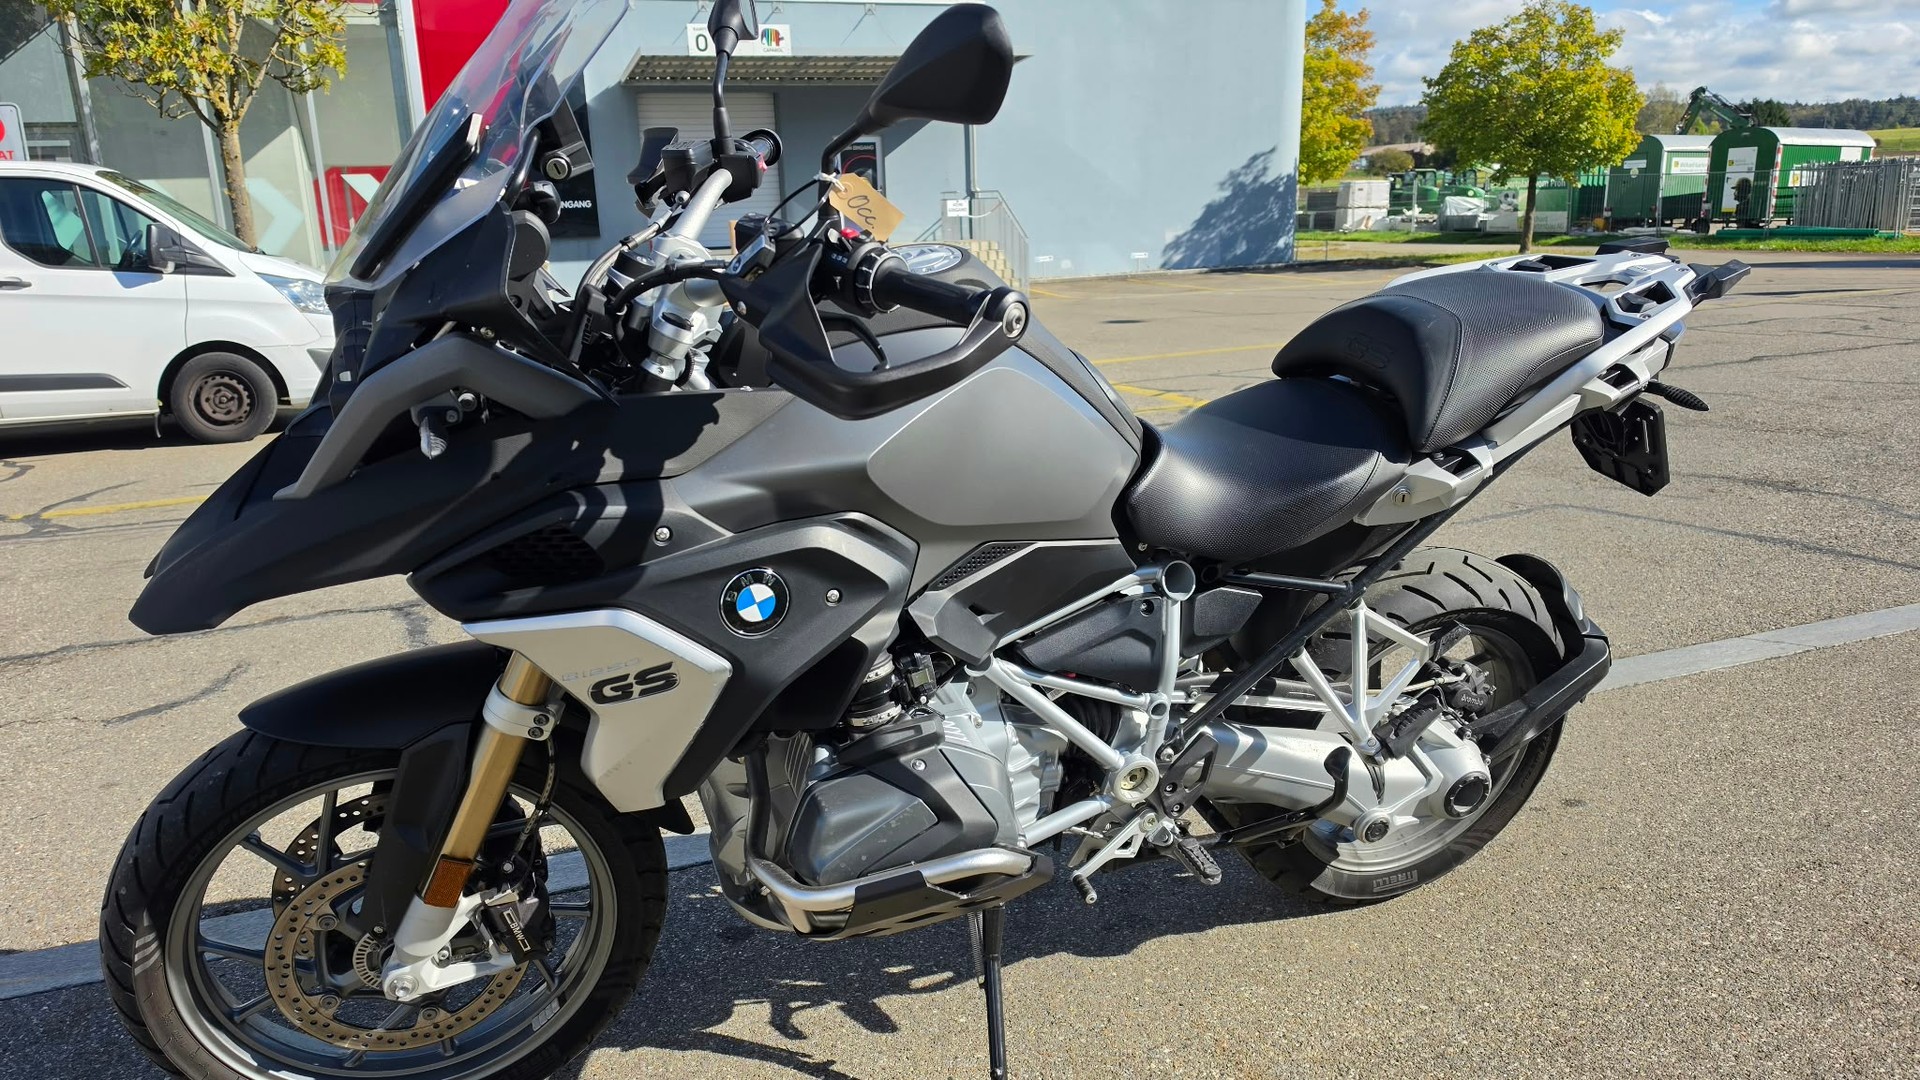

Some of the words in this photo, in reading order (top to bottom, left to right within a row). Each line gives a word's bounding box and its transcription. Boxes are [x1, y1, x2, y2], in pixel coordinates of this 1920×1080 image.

[561, 200, 592, 209] NGANG
[725, 572, 777, 602] BMW
[588, 661, 680, 705] GS
[1372, 869, 1419, 892] PIRELLI
[509, 921, 526, 941] BMW
